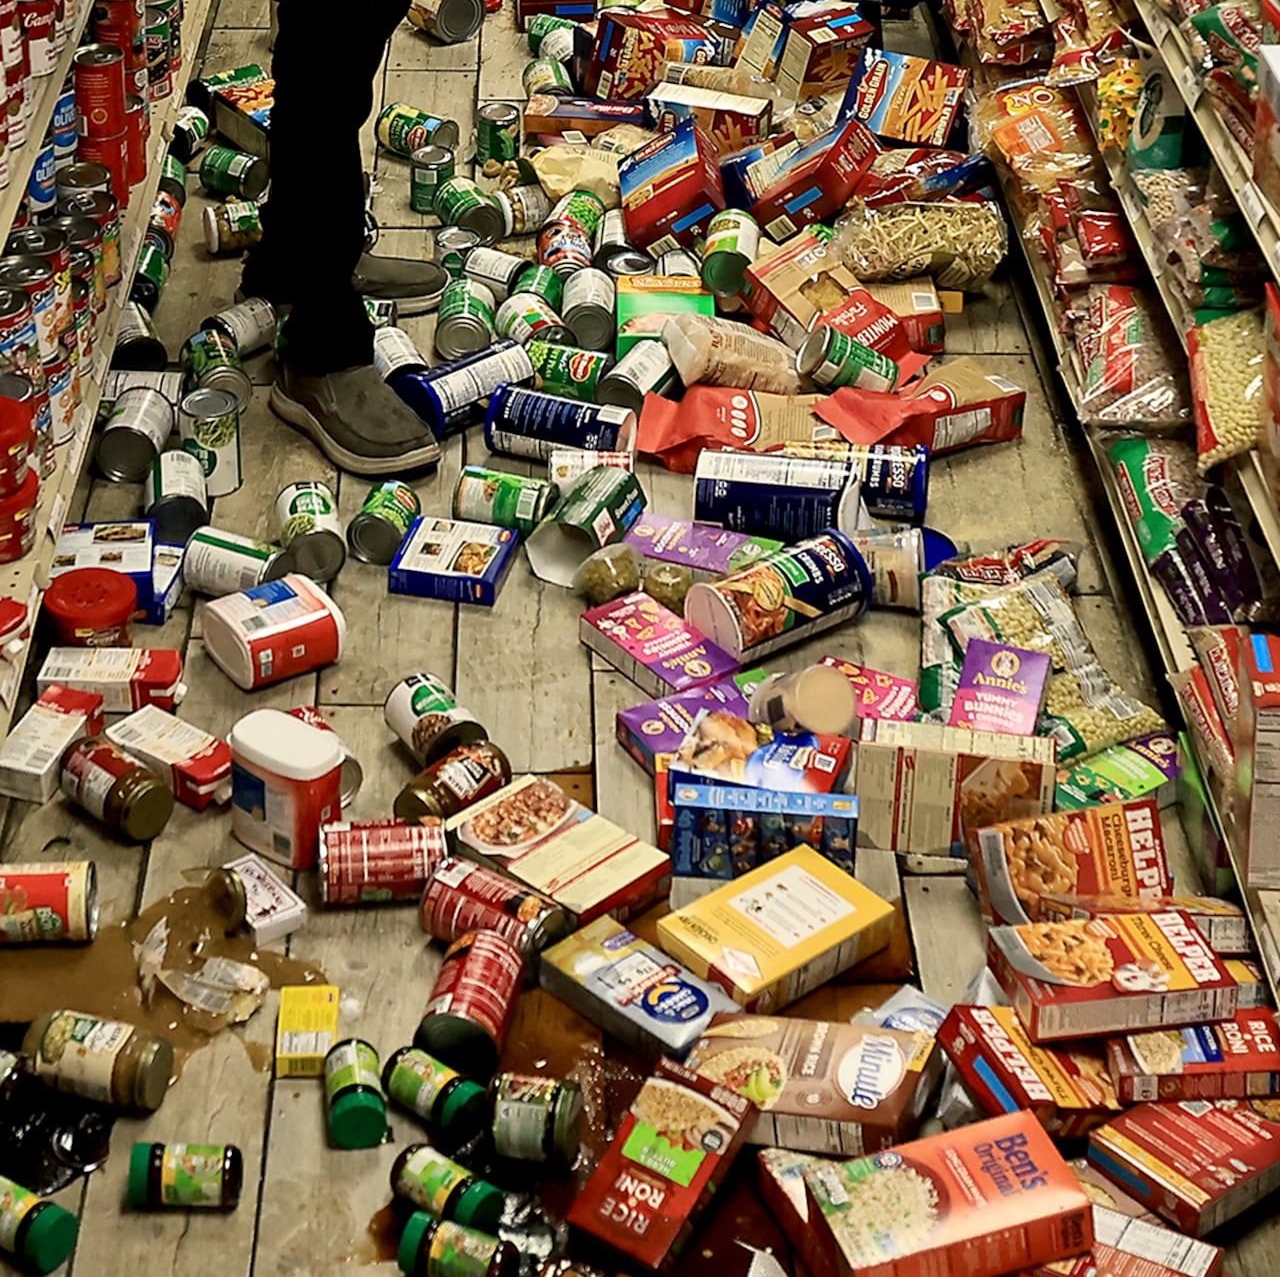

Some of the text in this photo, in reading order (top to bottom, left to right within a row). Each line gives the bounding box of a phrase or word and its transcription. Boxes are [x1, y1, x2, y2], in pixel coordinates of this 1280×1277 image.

[858, 62, 888, 120] GOLDEN GRAIN
[971, 670, 1031, 697] Annie's
[974, 691, 1019, 709] YUMMY
[962, 701, 1025, 722] BUNNIES
[1101, 815, 1119, 883] Macaroni
[1149, 912, 1221, 983] HELPER
[968, 1007, 1054, 1102] HELPER
[1222, 1022, 1249, 1055] RONI
[1248, 1020, 1276, 1054] RICE
[848, 1035, 897, 1109] Minute
[972, 1143, 1021, 1199] Original
[994, 1132, 1051, 1192] Ben's
[614, 1170, 666, 1210] RONI
[599, 1195, 651, 1236] RICE
